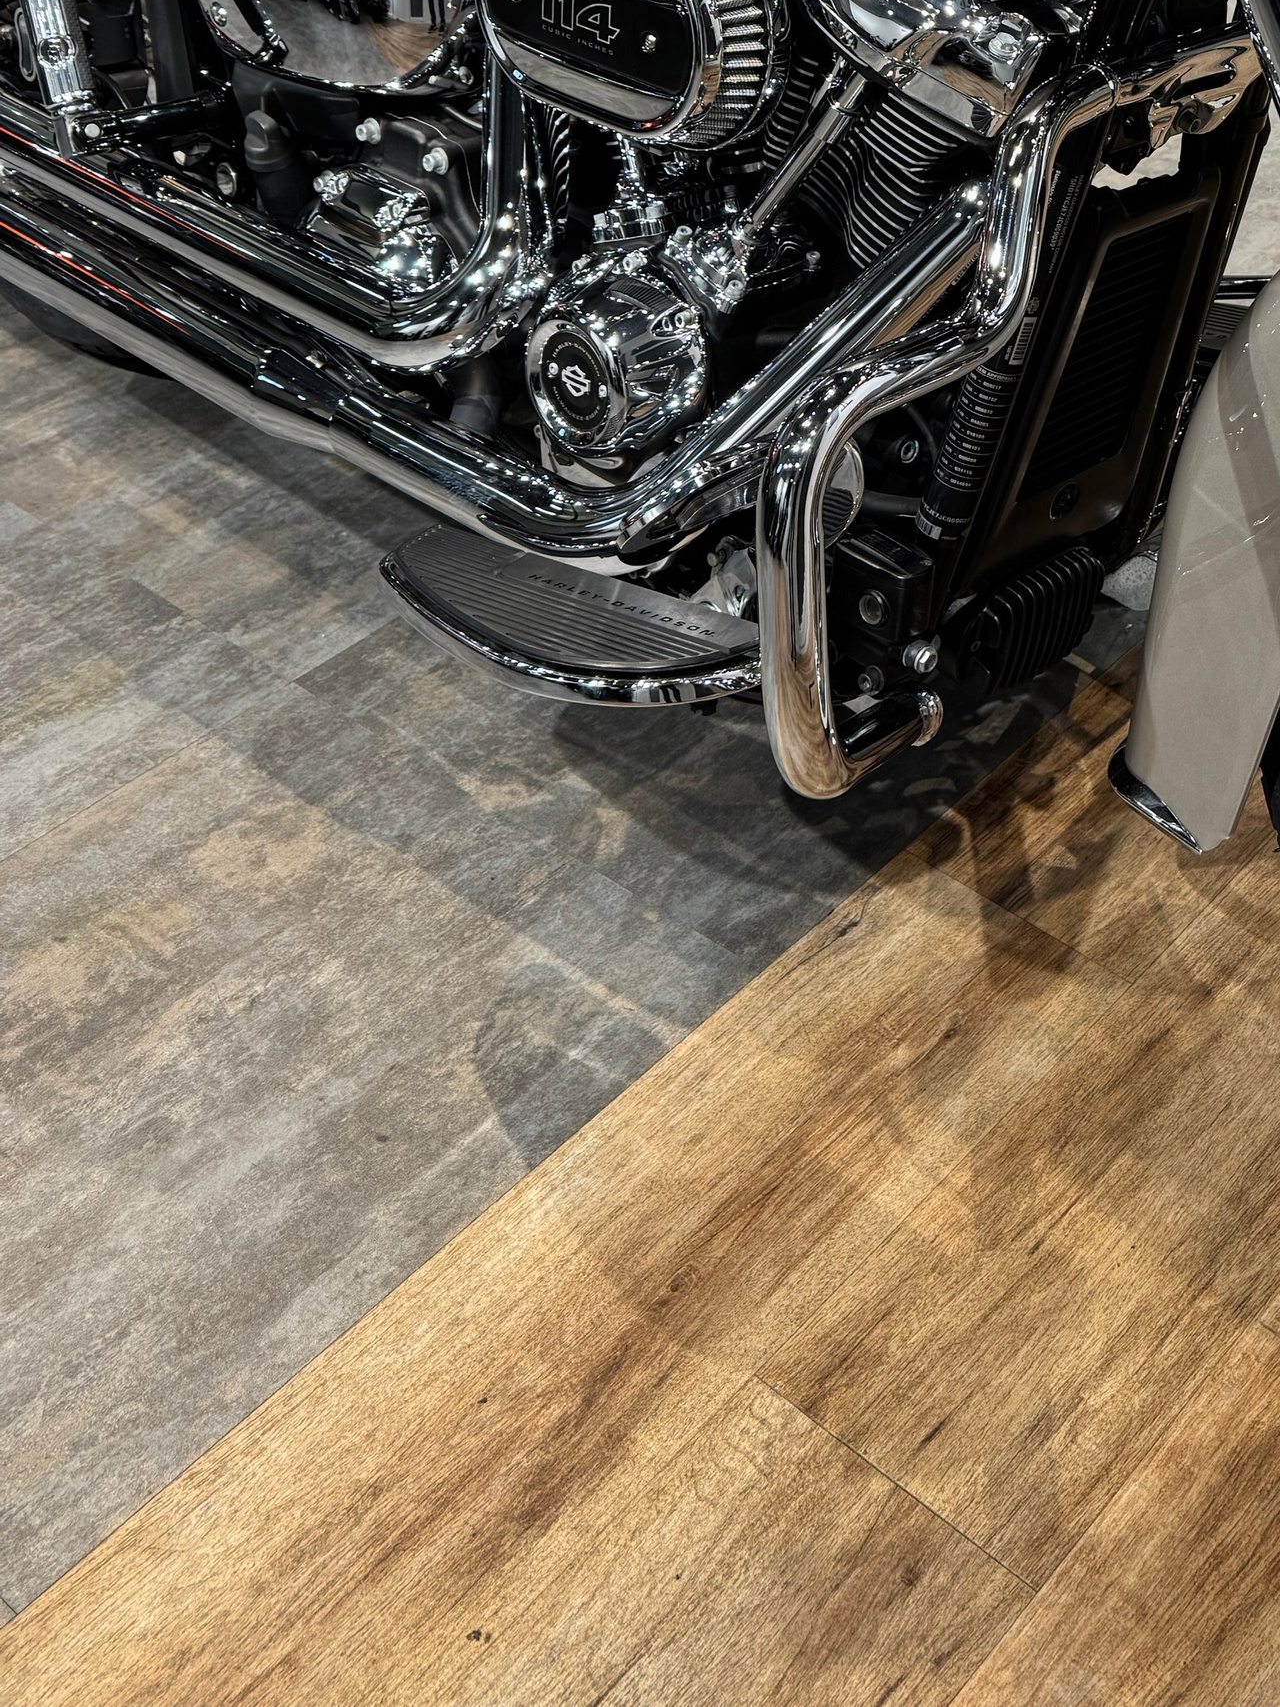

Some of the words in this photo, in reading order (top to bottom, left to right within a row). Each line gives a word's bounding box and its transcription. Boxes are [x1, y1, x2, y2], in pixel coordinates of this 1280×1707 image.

[542, 24, 571, 40] CUBIC
[577, 38, 614, 56] INCHES
[526, 572, 717, 639] HARLEY-DAVIDSON
